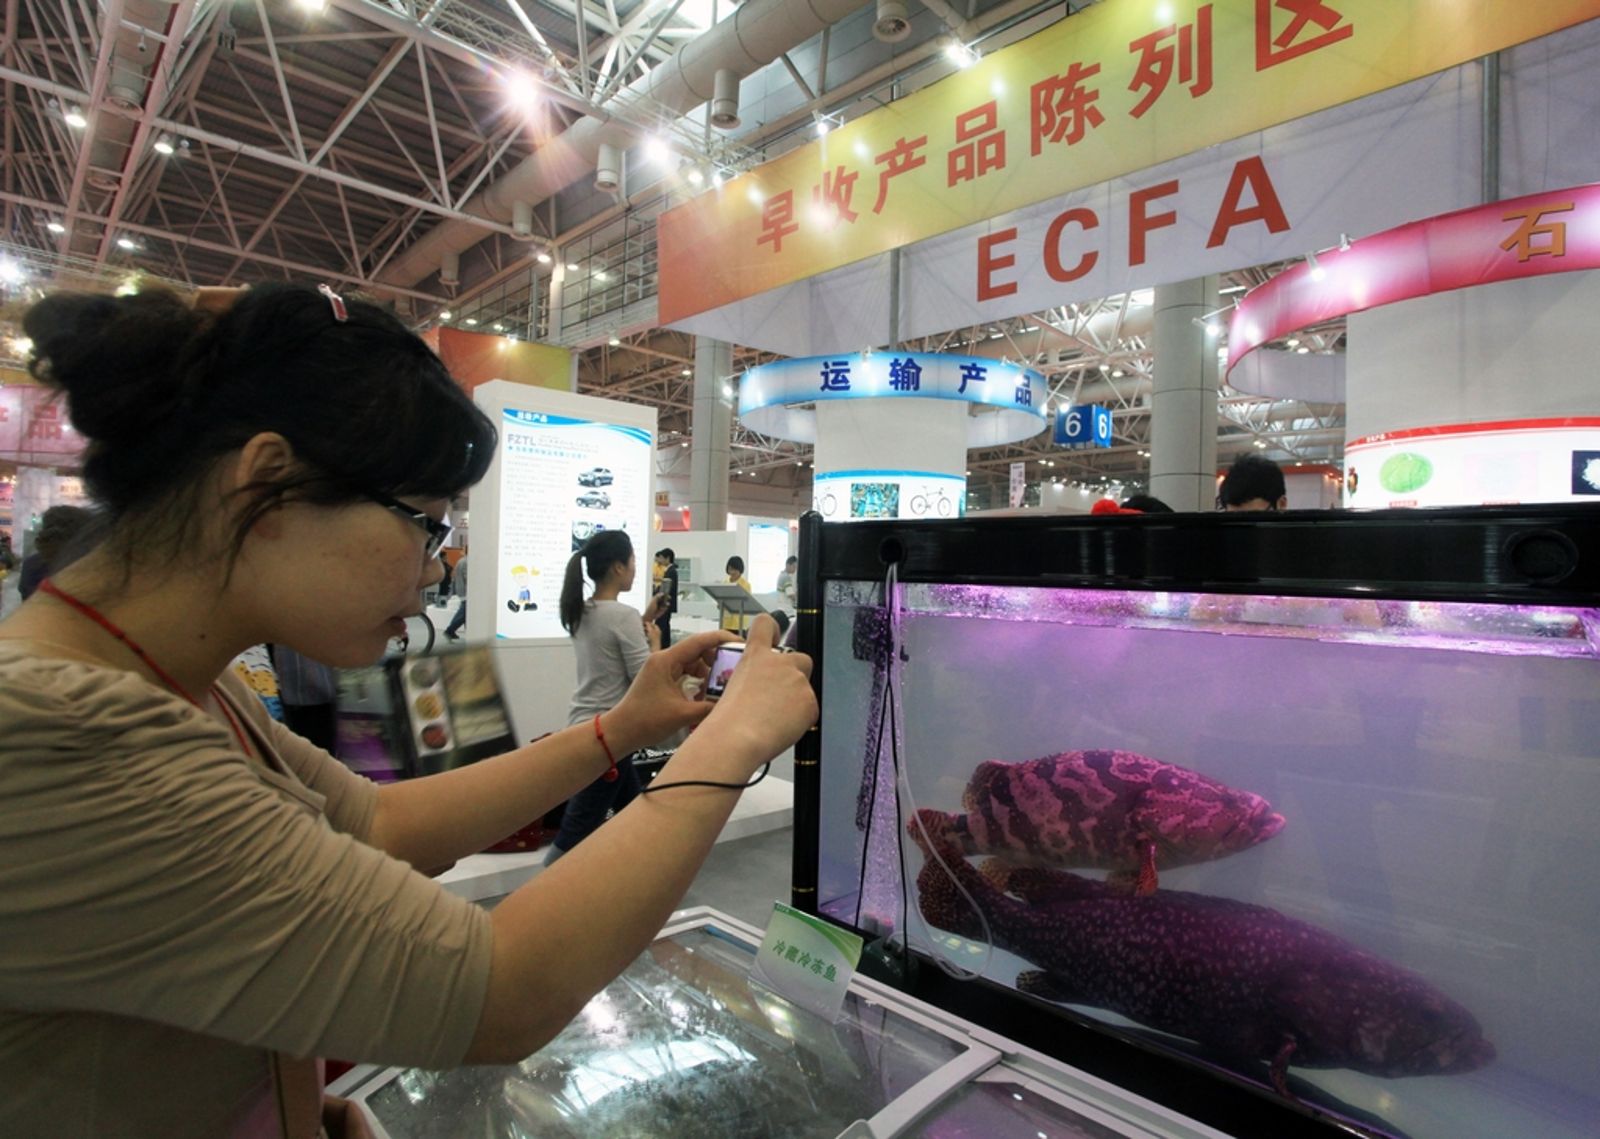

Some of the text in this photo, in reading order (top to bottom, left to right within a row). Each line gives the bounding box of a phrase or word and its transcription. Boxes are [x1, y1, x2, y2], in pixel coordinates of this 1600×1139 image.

[756, 0, 1354, 254] 早收产品陈列区
[976, 155, 1292, 303] ECFA
[1500, 203, 1574, 263] 石
[820, 357, 1032, 407] 运输产品
[507, 433, 537, 447] FZTL
[1064, 412, 1082, 437] 6
[1098, 413, 1108, 439] 6
